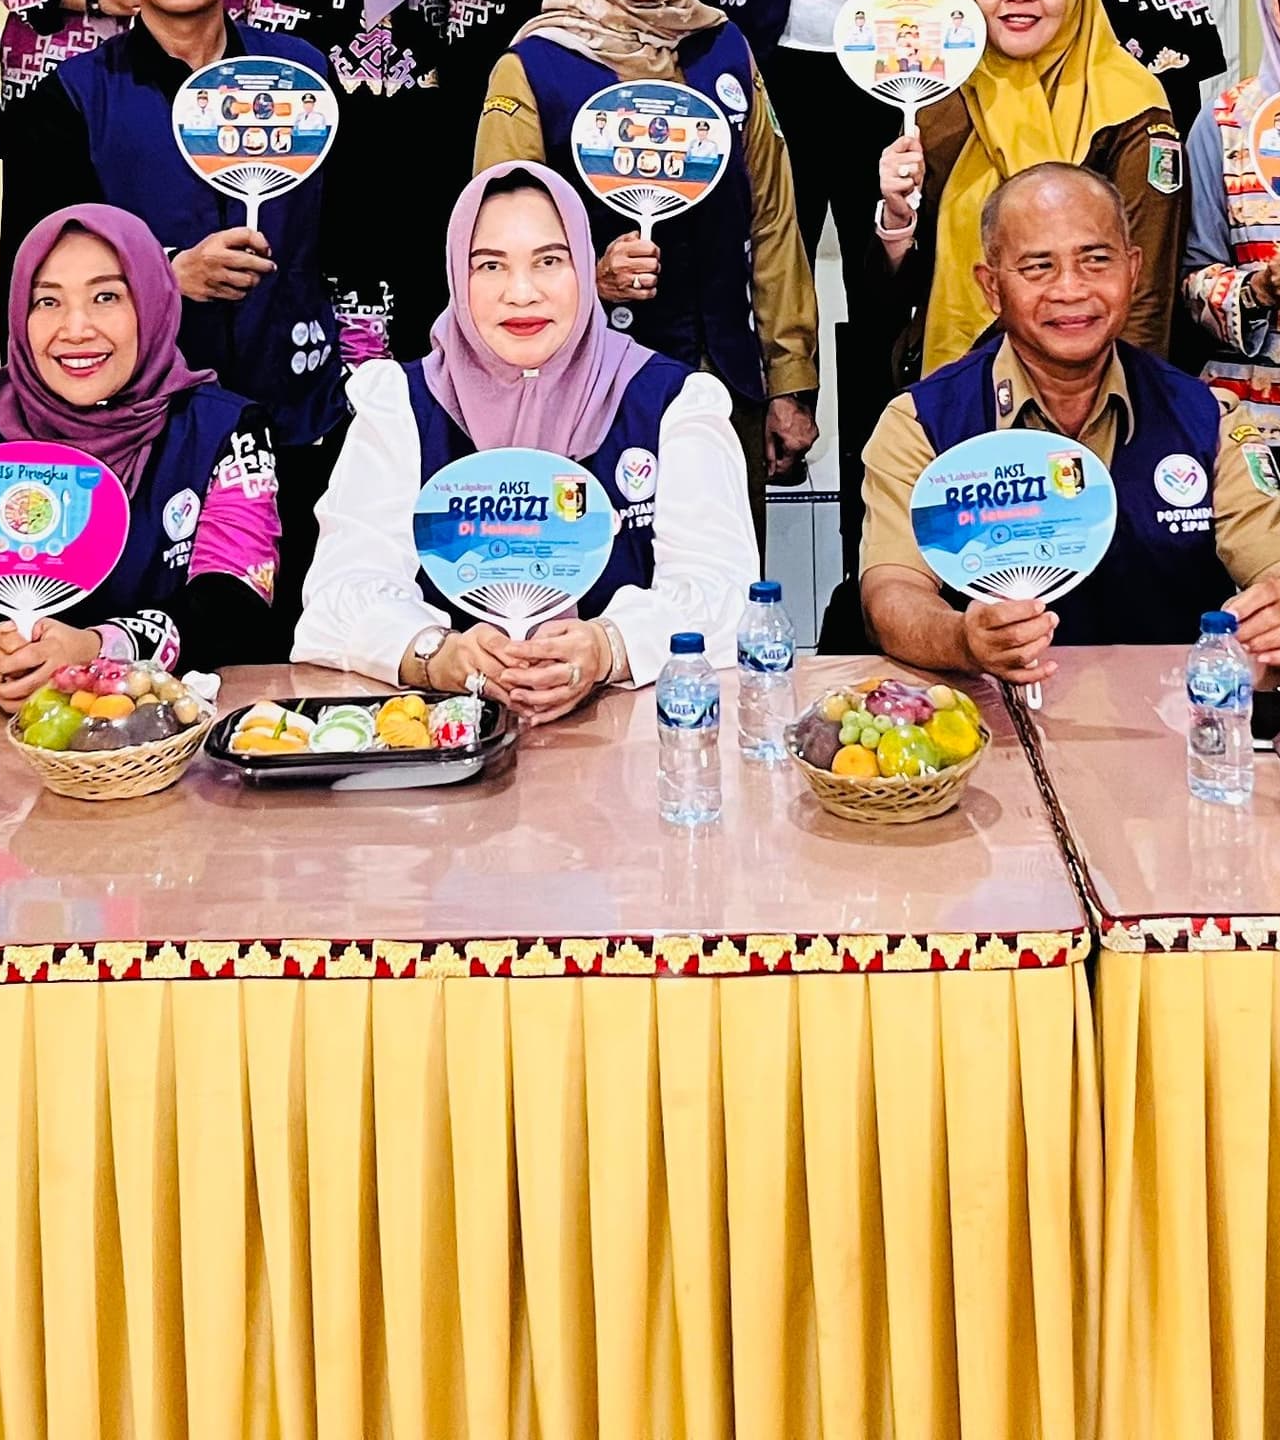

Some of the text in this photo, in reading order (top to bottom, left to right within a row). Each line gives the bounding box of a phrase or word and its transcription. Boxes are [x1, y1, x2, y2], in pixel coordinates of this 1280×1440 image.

[994, 463, 1026, 479] AKSI
[499, 481, 530, 495] AKSI
[945, 476, 1048, 511] BERGIZI
[448, 495, 549, 521] BERGIZI
[1169, 520, 1210, 533] 6 SPM
